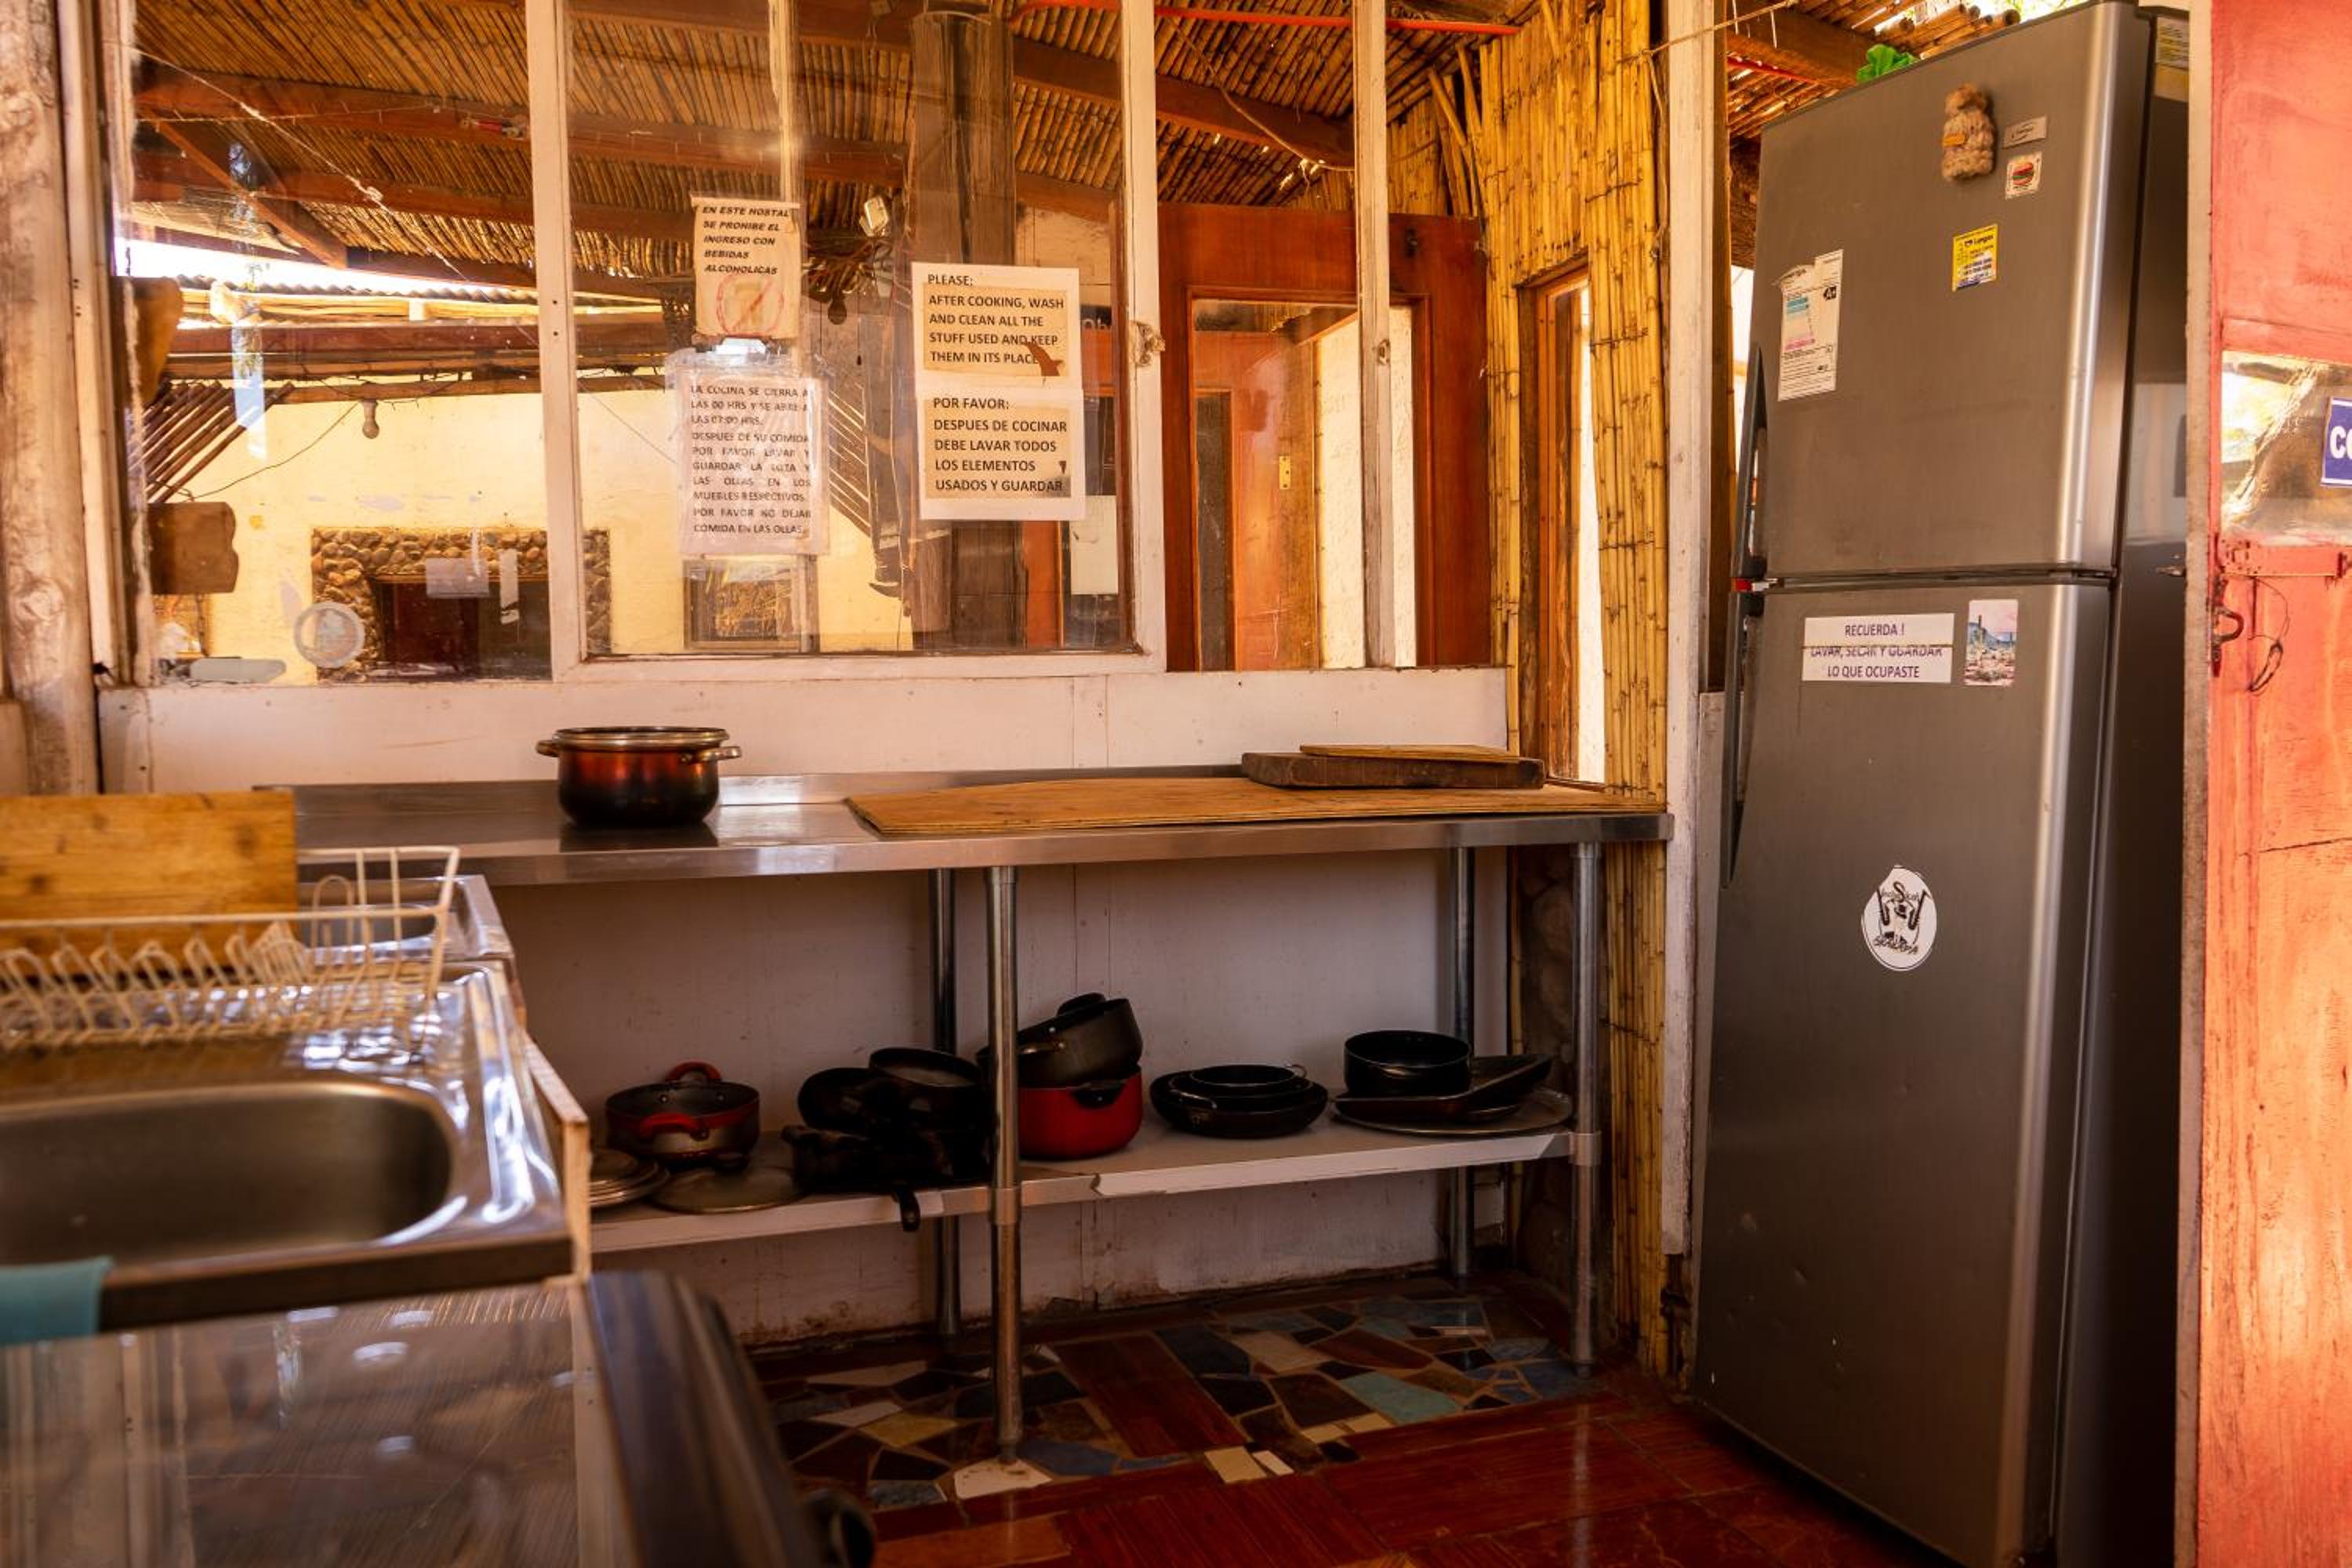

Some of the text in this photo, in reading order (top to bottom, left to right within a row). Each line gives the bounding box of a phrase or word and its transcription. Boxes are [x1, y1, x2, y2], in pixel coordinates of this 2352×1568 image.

[720, 206, 746, 216] ESTE
[749, 207, 789, 217] HOSTAL
[703, 220, 717, 229] SE
[720, 221, 766, 231] PROHIBE
[703, 235, 775, 245] INGRESO CON
[704, 250, 750, 260] BEBIDAS
[704, 264, 779, 275] ALCOHOLICAS
[927, 274, 974, 286] PLEASE:
[929, 295, 1064, 310] AFTER COOKING, WASH
[929, 314, 1044, 327] AND CLEAN ALL THE
[929, 332, 1058, 346] STUFF USED AND KEEP
[931, 350, 965, 363] THEM
[969, 352, 981, 363] IN
[984, 352, 1000, 363] ITS
[691, 385, 703, 394] LA
[748, 387, 760, 396] SE
[764, 387, 798, 397] CIERRA
[691, 400, 709, 410] LAS
[727, 401, 747, 411] HRS
[750, 401, 757, 411] Y
[934, 397, 1010, 410] POR FAVOR:
[691, 415, 710, 424] LAS
[934, 419, 1067, 433] DESPUES DE COCINAR
[692, 446, 713, 456] POR
[935, 439, 1057, 452] DEBE LAVAR TODOS
[750, 462, 763, 471] LA
[935, 459, 1036, 472] LOS ELEMENTOS
[693, 476, 710, 486] LAS
[768, 477, 780, 487] EN
[793, 478, 811, 488] LOS
[936, 479, 1063, 492] USADOS Y GUARDAR
[693, 508, 714, 518] POR
[760, 509, 775, 519] NO
[693, 524, 735, 534] COMIDA
[753, 524, 771, 535] LAS
[1845, 622, 1905, 637] RECUERDA !
[1828, 666, 1920, 679] LO QUE OCUPASTE
